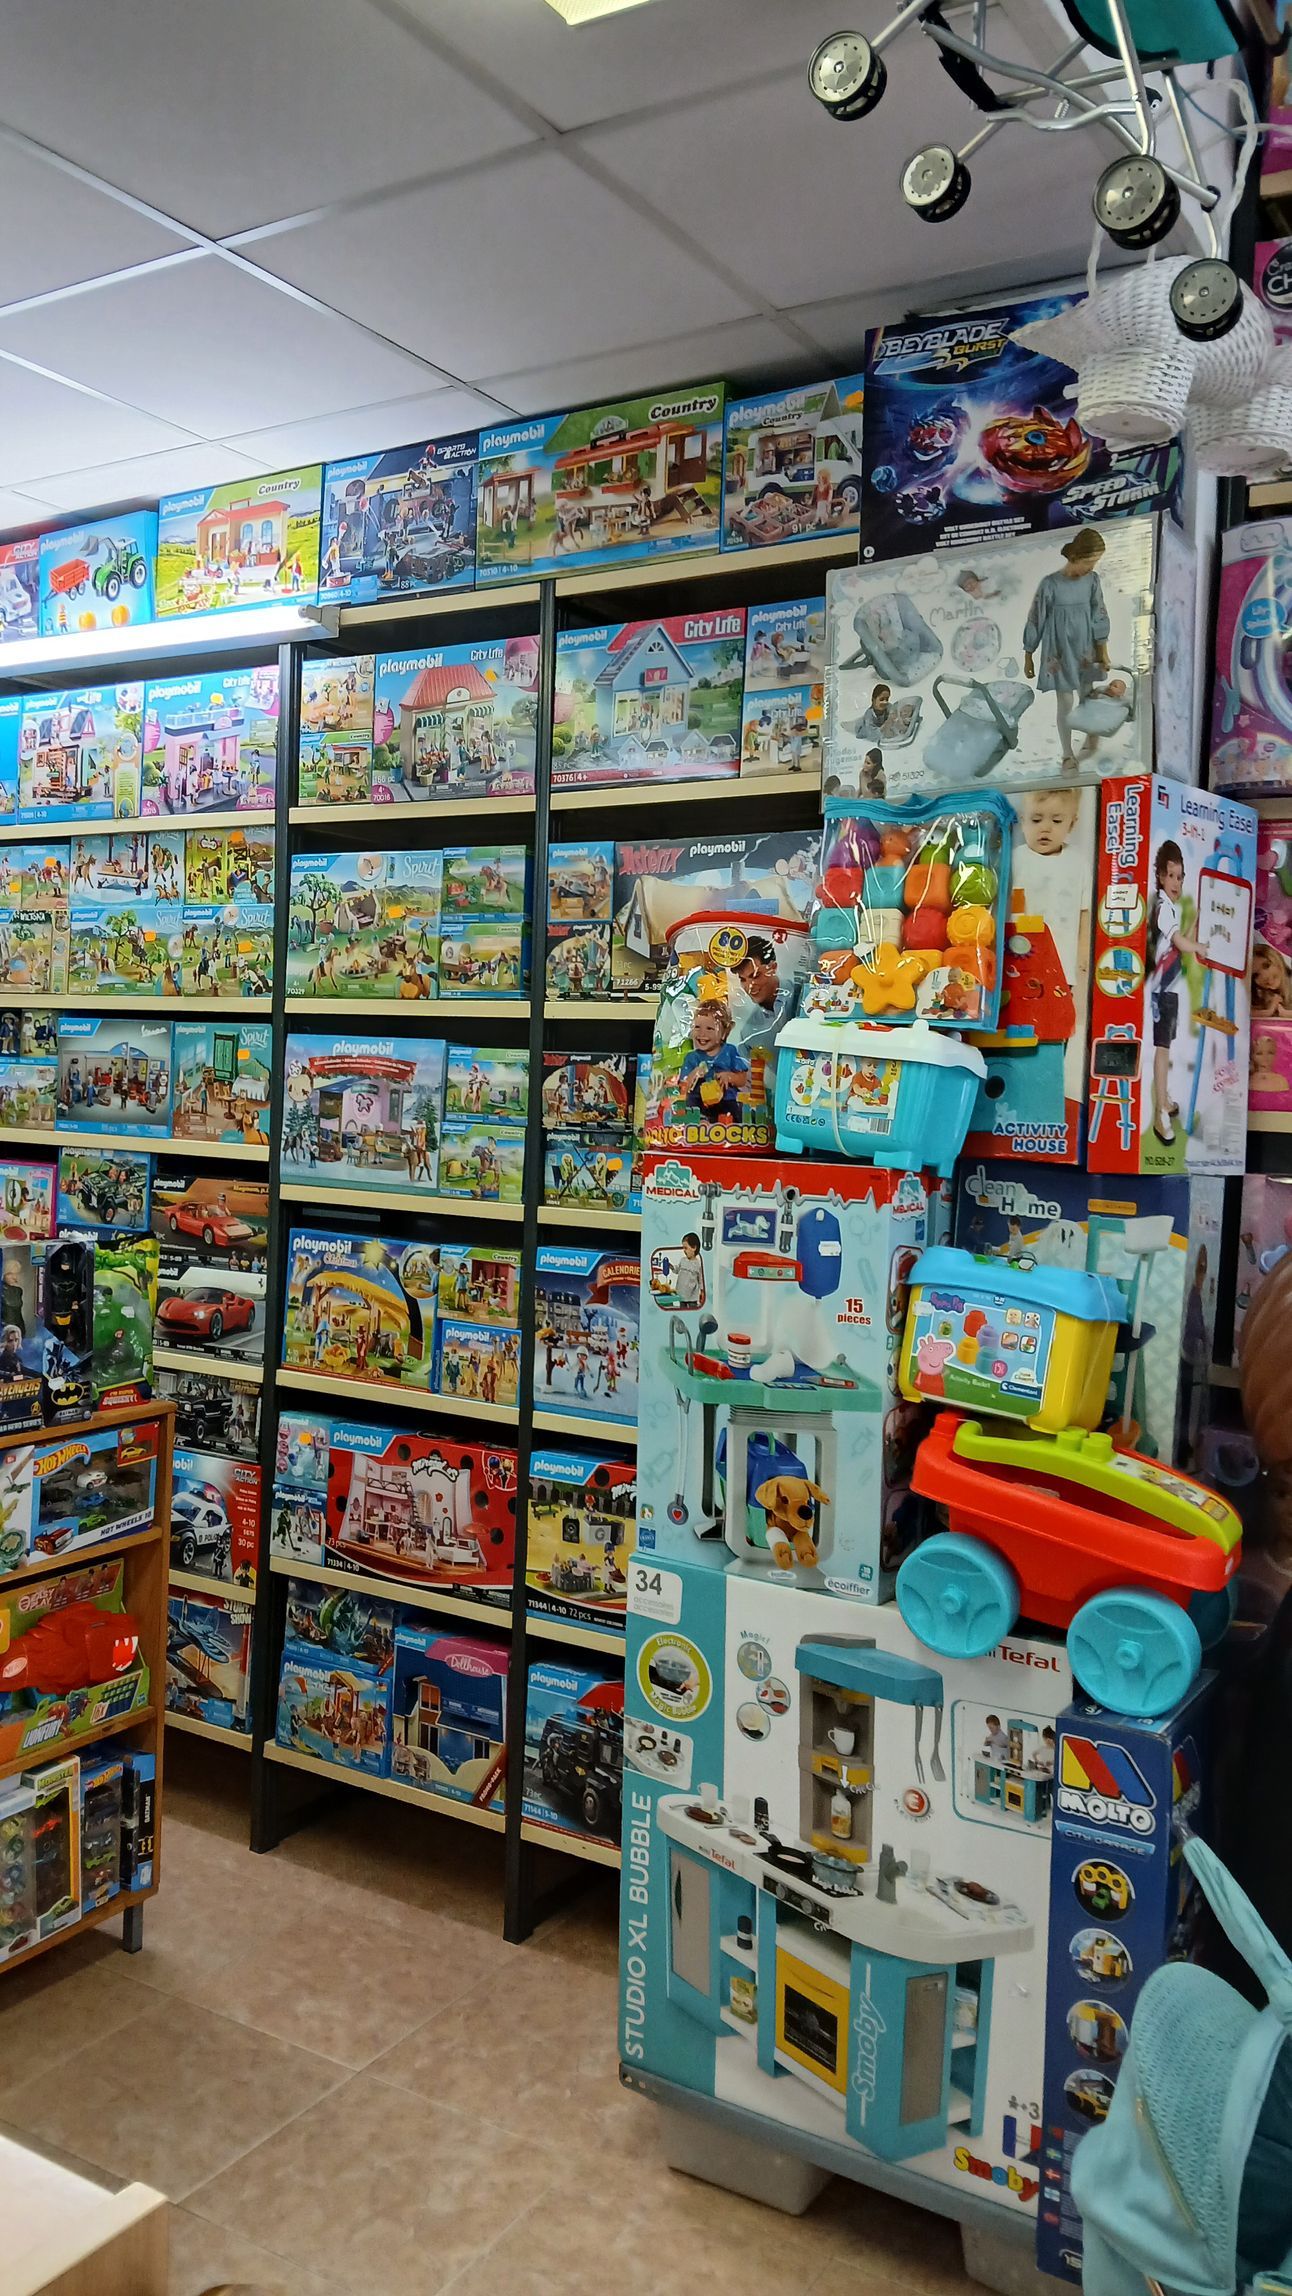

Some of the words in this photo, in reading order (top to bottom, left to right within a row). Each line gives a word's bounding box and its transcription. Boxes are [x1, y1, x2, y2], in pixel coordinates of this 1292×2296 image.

[882, 321, 1004, 357] BEYBLADE
[954, 338, 1005, 356] BURST
[651, 397, 717, 418] Country
[762, 411, 804, 426] Country
[483, 424, 545, 451] playmobil
[328, 460, 367, 479] playmobil
[258, 478, 301, 494] Country
[1062, 477, 1128, 504] SPEED
[163, 494, 205, 515] playmobil
[1093, 482, 1160, 511] STORM
[41, 530, 85, 554] playmobil
[751, 605, 808, 626] playmobil
[684, 620, 713, 639] City
[715, 616, 741, 634] Life
[558, 631, 608, 649] playmobil
[470, 649, 487, 662] City
[380, 654, 443, 677] playmobil
[149, 681, 202, 702] playmobil
[0, 702, 19, 713] mobil
[553, 773, 574, 783] 70376
[577, 772, 588, 781] 4+
[1181, 794, 1225, 830] Learning
[1107, 801, 1122, 854] Easel
[1121, 784, 1143, 866] Learning
[552, 848, 588, 859] playmobil
[690, 841, 746, 858] playmobil
[292, 857, 328, 870] playmobil
[403, 857, 440, 878] Spirit
[156, 911, 182, 929] Spirit
[241, 909, 271, 929] Spirit
[719, 931, 743, 950] 80
[61, 1024, 91, 1033] playmobil
[176, 1025, 207, 1035] playmobil
[240, 1028, 270, 1048] Spirit
[333, 1040, 394, 1057] playmobil
[687, 1125, 769, 1146] BLOCKS
[994, 1122, 1067, 1137] ACTIVITY
[1014, 1138, 1067, 1153] HOUSE
[0, 1167, 19, 1176] mobil
[154, 1178, 185, 1189] playmobil
[646, 1186, 699, 1199] MEDICAL
[1002, 1197, 1058, 1217] Hme
[293, 1237, 352, 1254] playmobil
[493, 1254, 518, 1262] Country
[540, 1254, 588, 1268] playmobil
[602, 1265, 641, 1279] CALENDRIE
[845, 1298, 863, 1314] 15
[838, 1313, 871, 1325] pieces
[446, 1328, 490, 1342] playmobil
[1008, 1385, 1038, 1396] Clementoni
[334, 1430, 382, 1448] playmobil
[38, 1456, 58, 1475] HOT
[58, 1444, 87, 1466] WHEELS
[534, 1460, 584, 1477] playmobil
[235, 1468, 256, 1478] CITY
[100, 1525, 114, 1536] HOT
[115, 1514, 142, 1530] WHEELS
[242, 1519, 255, 1528] 4-10
[238, 1538, 246, 1547] 30
[347, 1563, 359, 1572] 4-10
[636, 1570, 662, 1596] 34
[231, 1613, 251, 1625] SHOW
[528, 1599, 547, 1610] 71344
[552, 1604, 567, 1615] 4-10
[569, 1607, 578, 1618] 72
[578, 1609, 592, 1621] pcs
[396, 1633, 426, 1646] playmobil
[998, 1644, 1060, 1673] Tefal
[284, 1661, 330, 1681] playmobil
[531, 1672, 578, 1691] playmobil
[1060, 1789, 1152, 1833] MOLTO
[628, 1791, 652, 1906] BUBBLE
[710, 1847, 736, 1871] Tefal
[628, 1909, 649, 1952] XL
[624, 1955, 648, 2060] STUDIO
[953, 2146, 1040, 2201] Smoby
